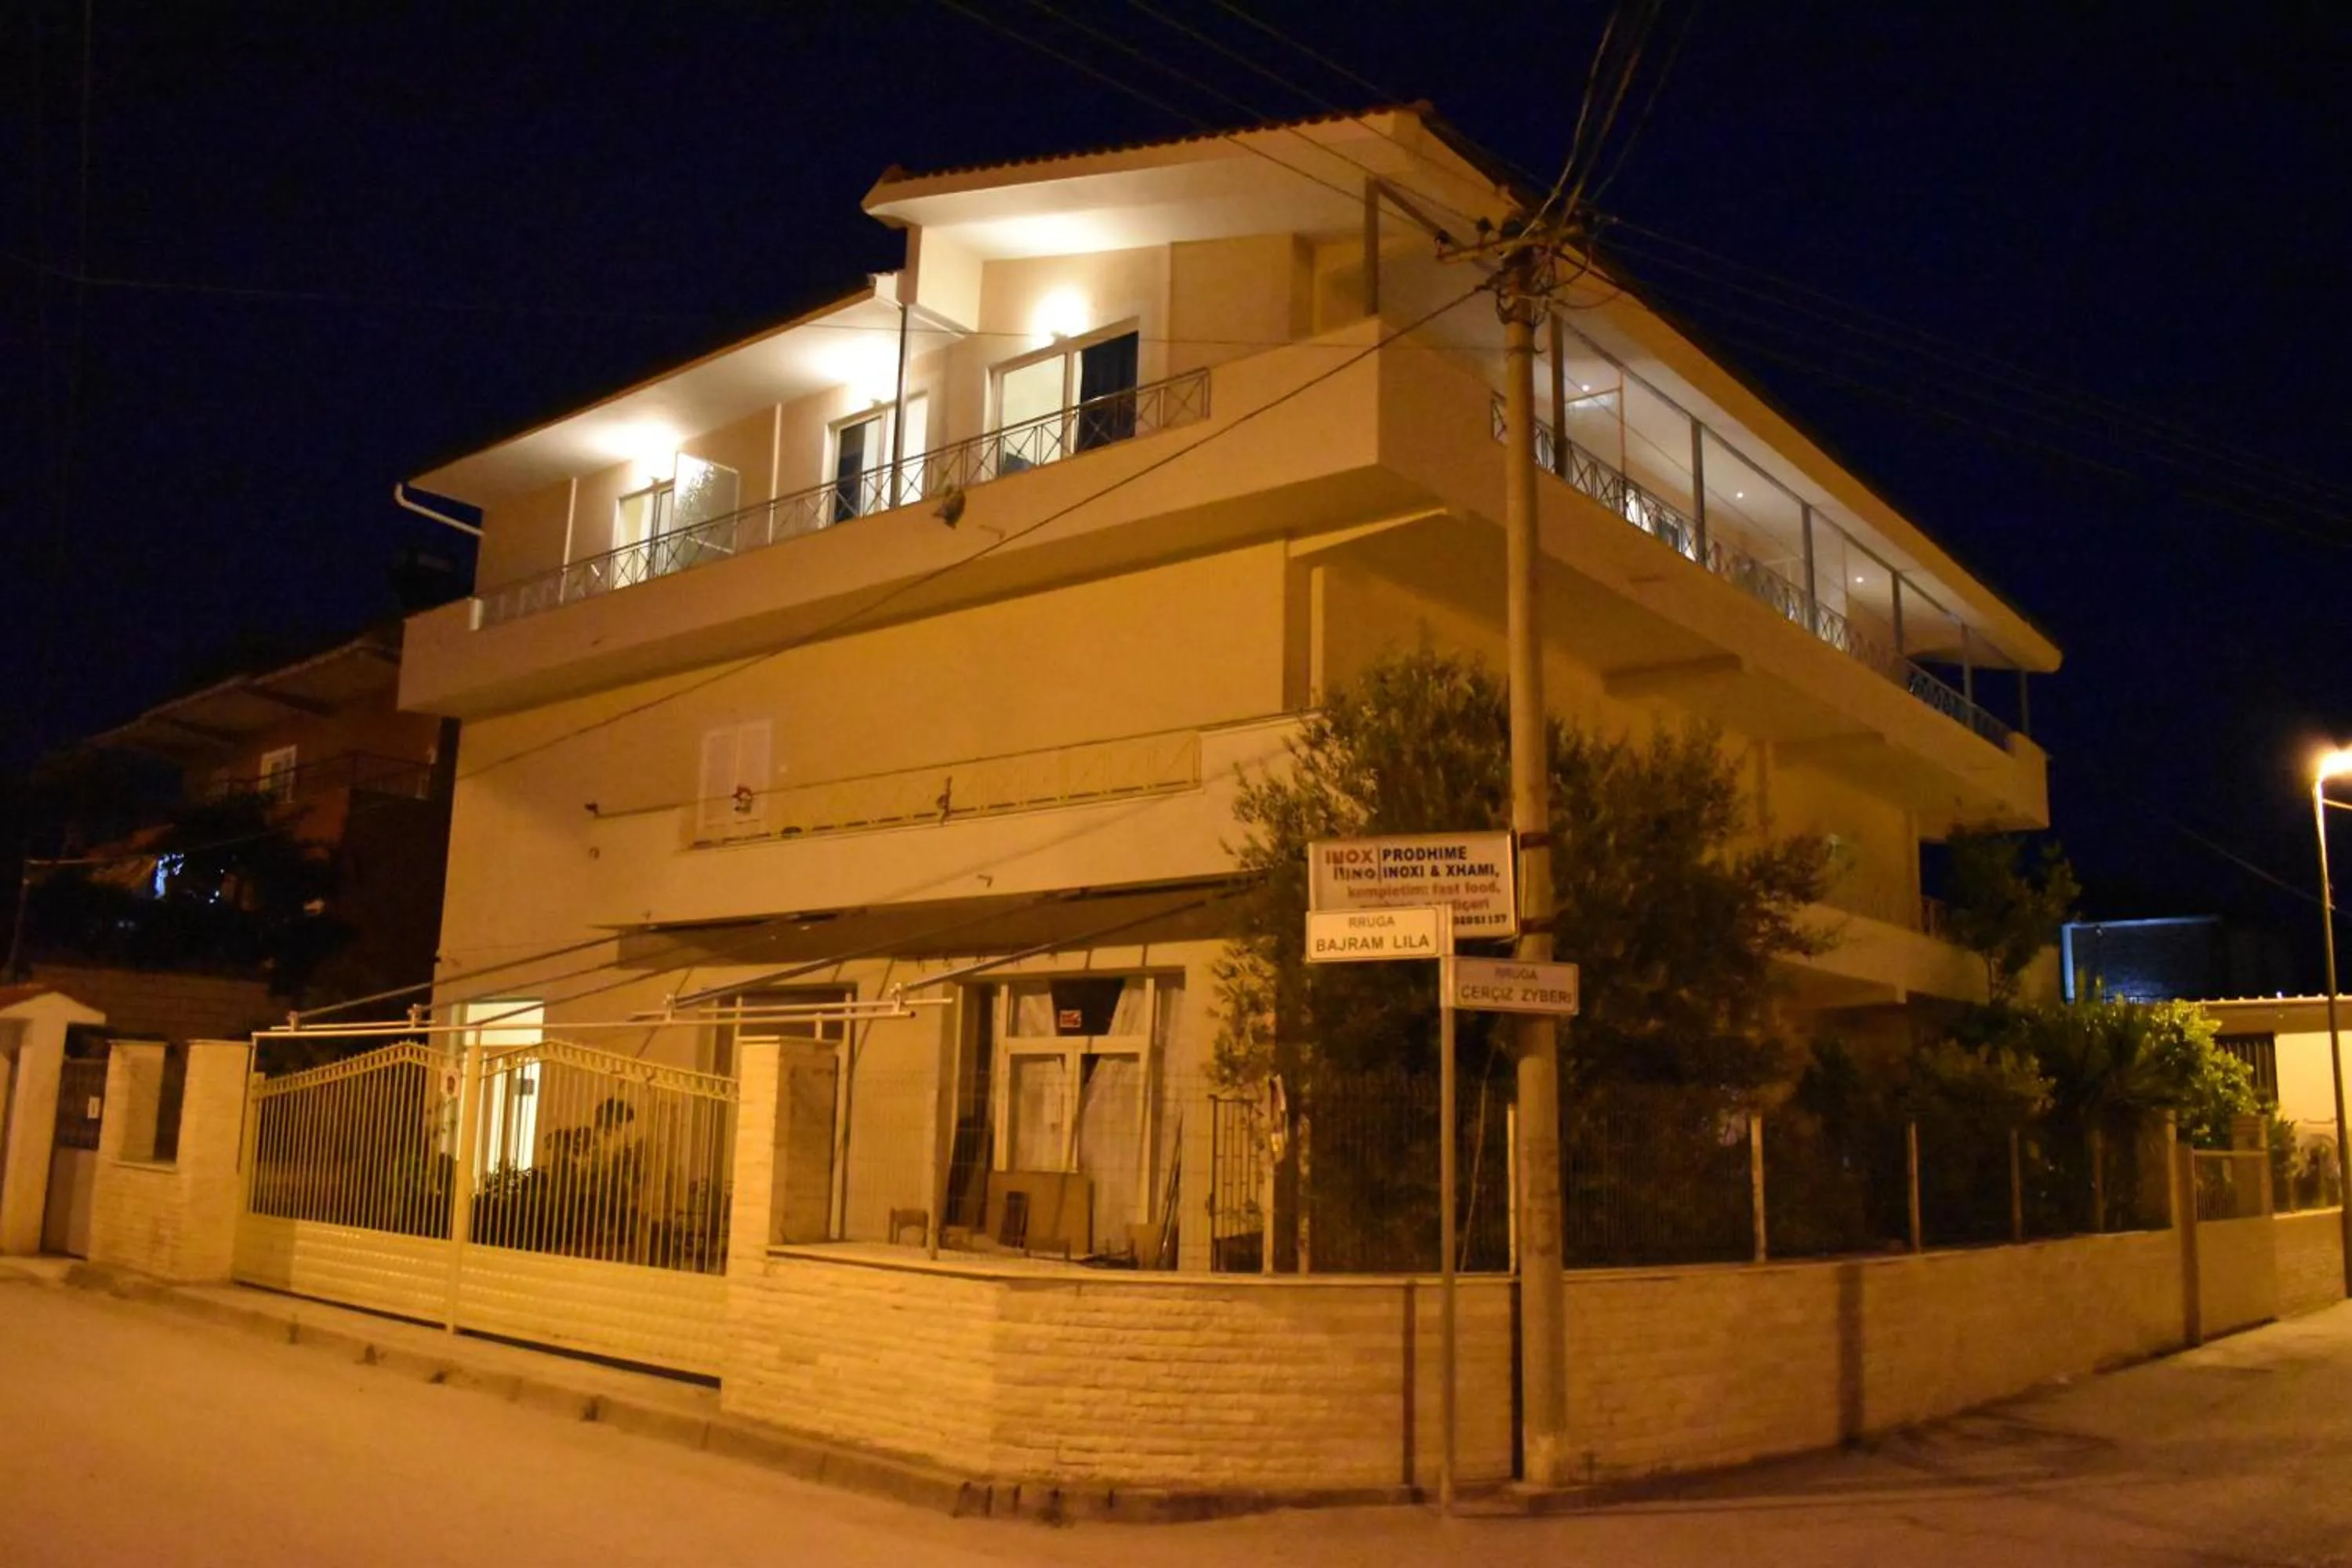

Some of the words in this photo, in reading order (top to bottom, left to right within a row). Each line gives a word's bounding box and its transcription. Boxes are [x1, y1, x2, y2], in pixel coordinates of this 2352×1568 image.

[1325, 849, 1374, 865] INOX
[1382, 846, 1467, 862] PRODHIME
[1383, 865, 1424, 878] INOXI
[1430, 865, 1439, 877] &
[1348, 916, 1396, 928] RRUGA
[1316, 936, 1385, 953] BAJRAM
[1393, 933, 1429, 949] LILA
